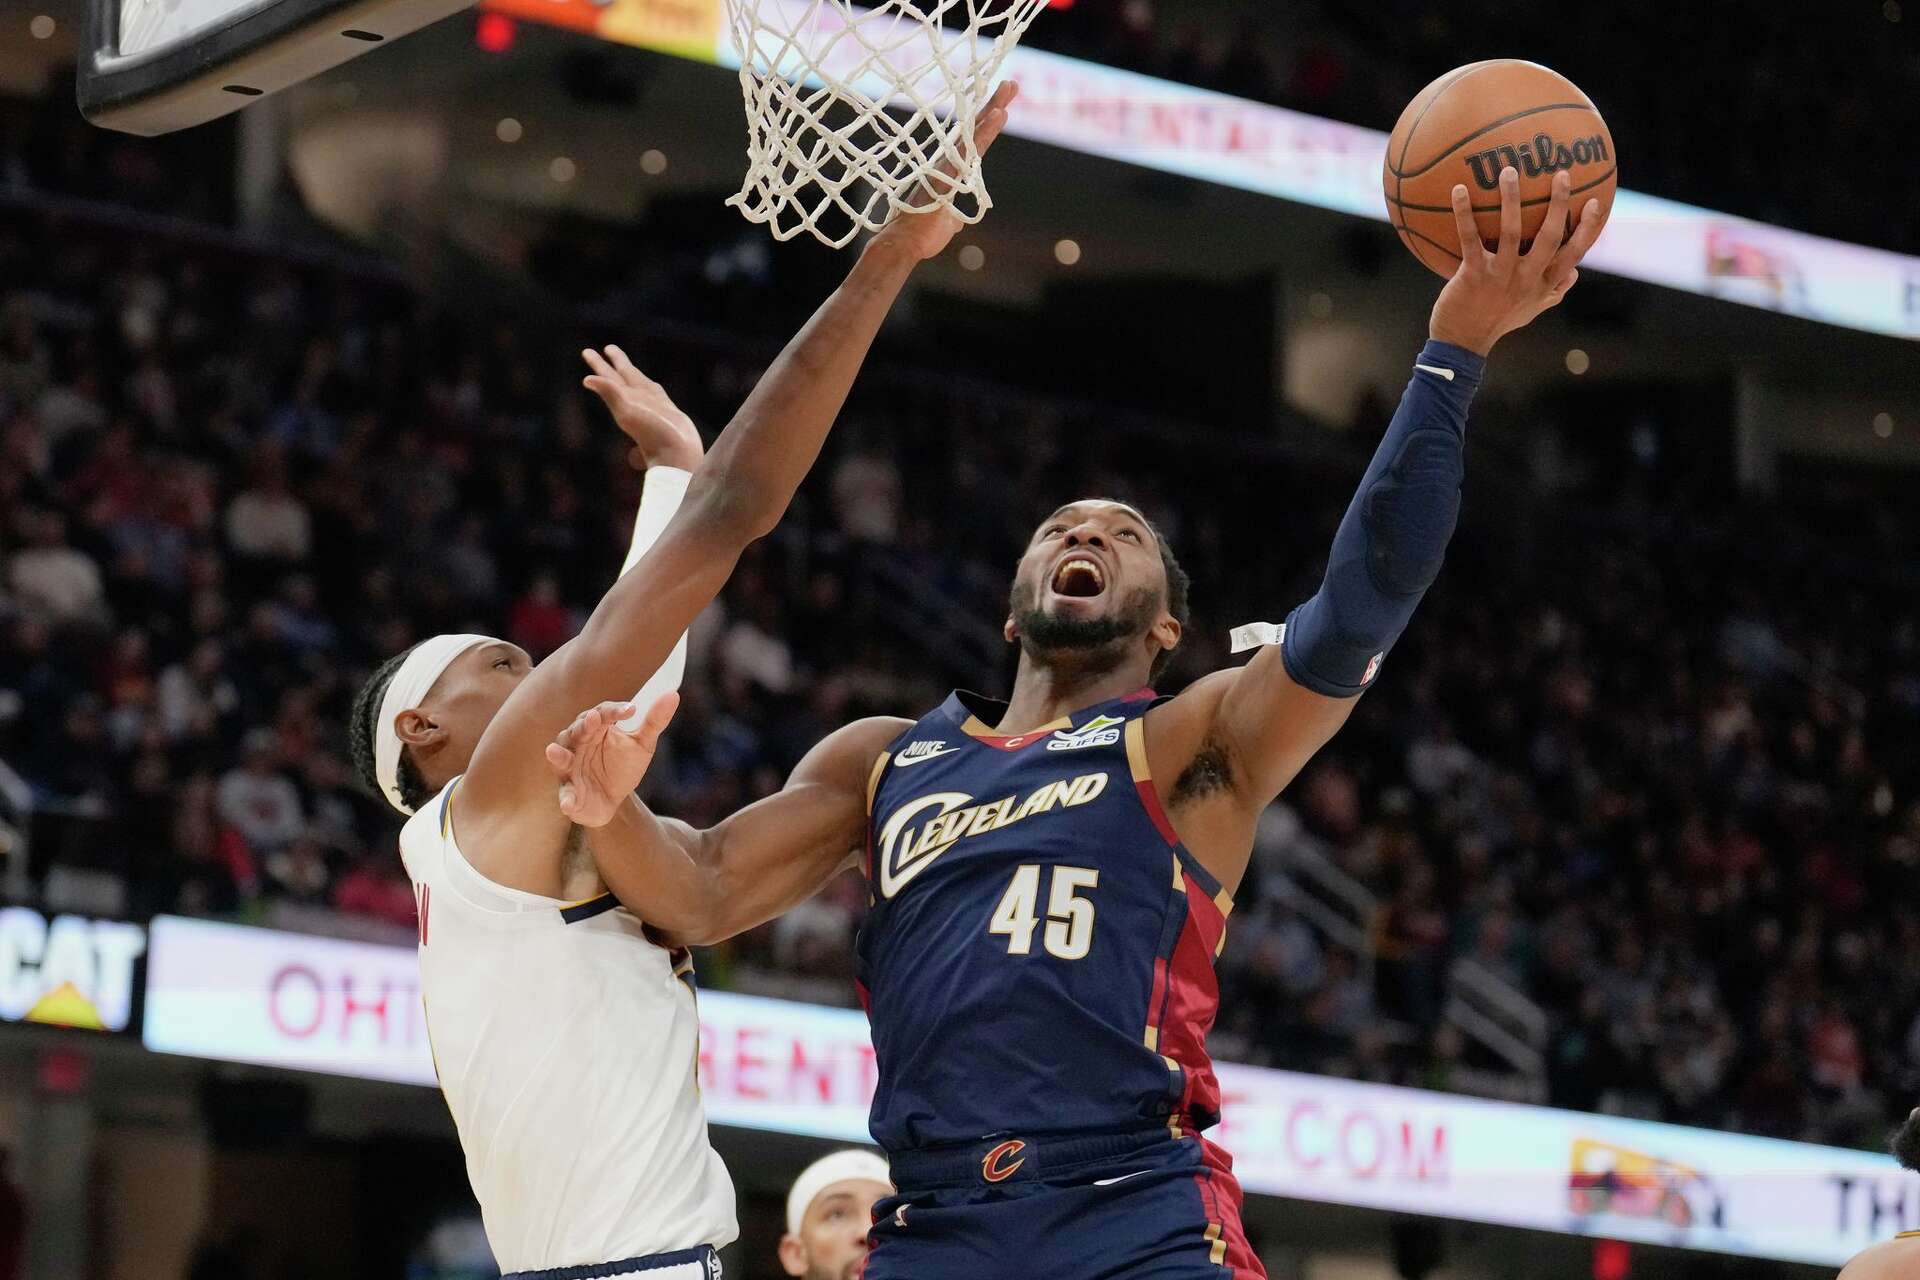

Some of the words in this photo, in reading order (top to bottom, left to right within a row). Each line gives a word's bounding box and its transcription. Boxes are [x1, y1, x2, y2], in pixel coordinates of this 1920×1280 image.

[1464, 131, 1610, 191] Wilson
[905, 740, 947, 757] NIKE
[1050, 731, 1117, 750] CLIFFS
[988, 863, 1100, 961] 45
[0, 906, 147, 1032] CAT
[1822, 1173, 1920, 1240] TH
